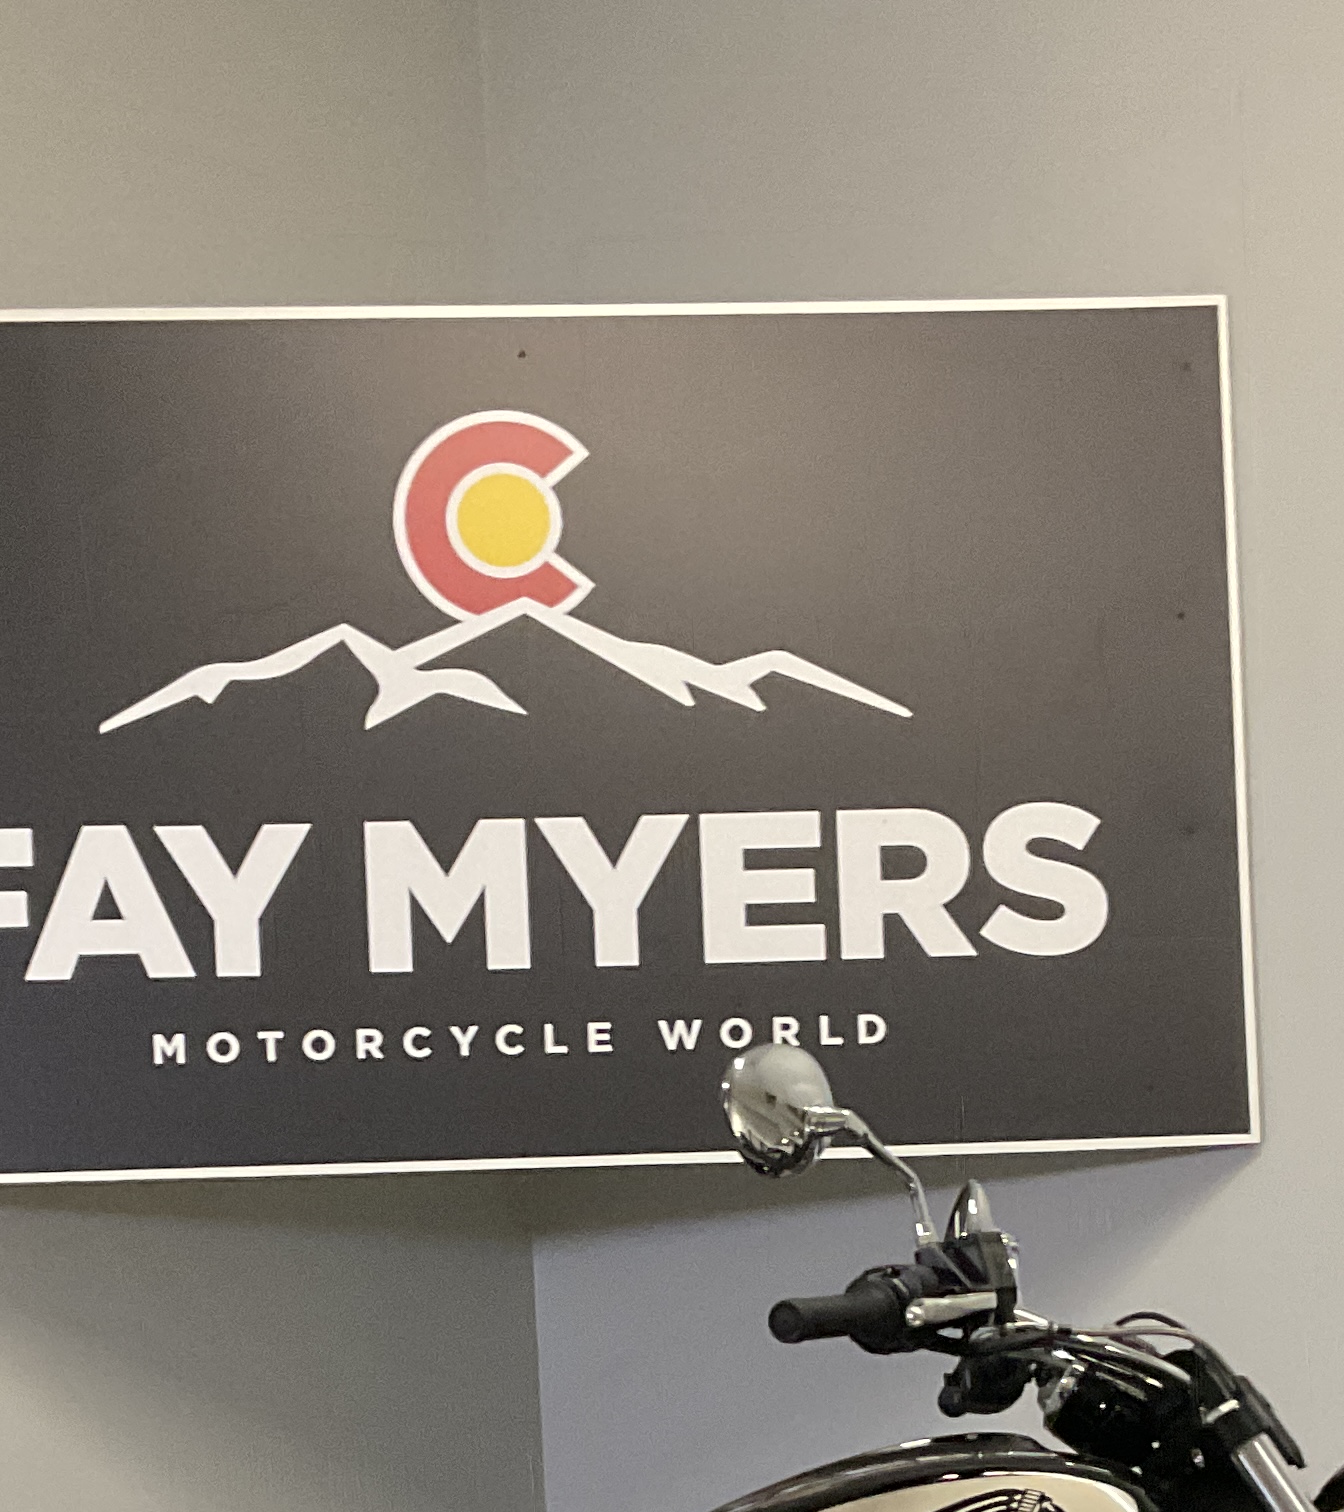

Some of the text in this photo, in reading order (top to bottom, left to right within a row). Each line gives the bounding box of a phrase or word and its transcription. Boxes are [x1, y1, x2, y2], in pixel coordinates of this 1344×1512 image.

[364, 802, 1108, 972] MYERS
[153, 1012, 890, 1064] MOTORCYCLE WORLD
